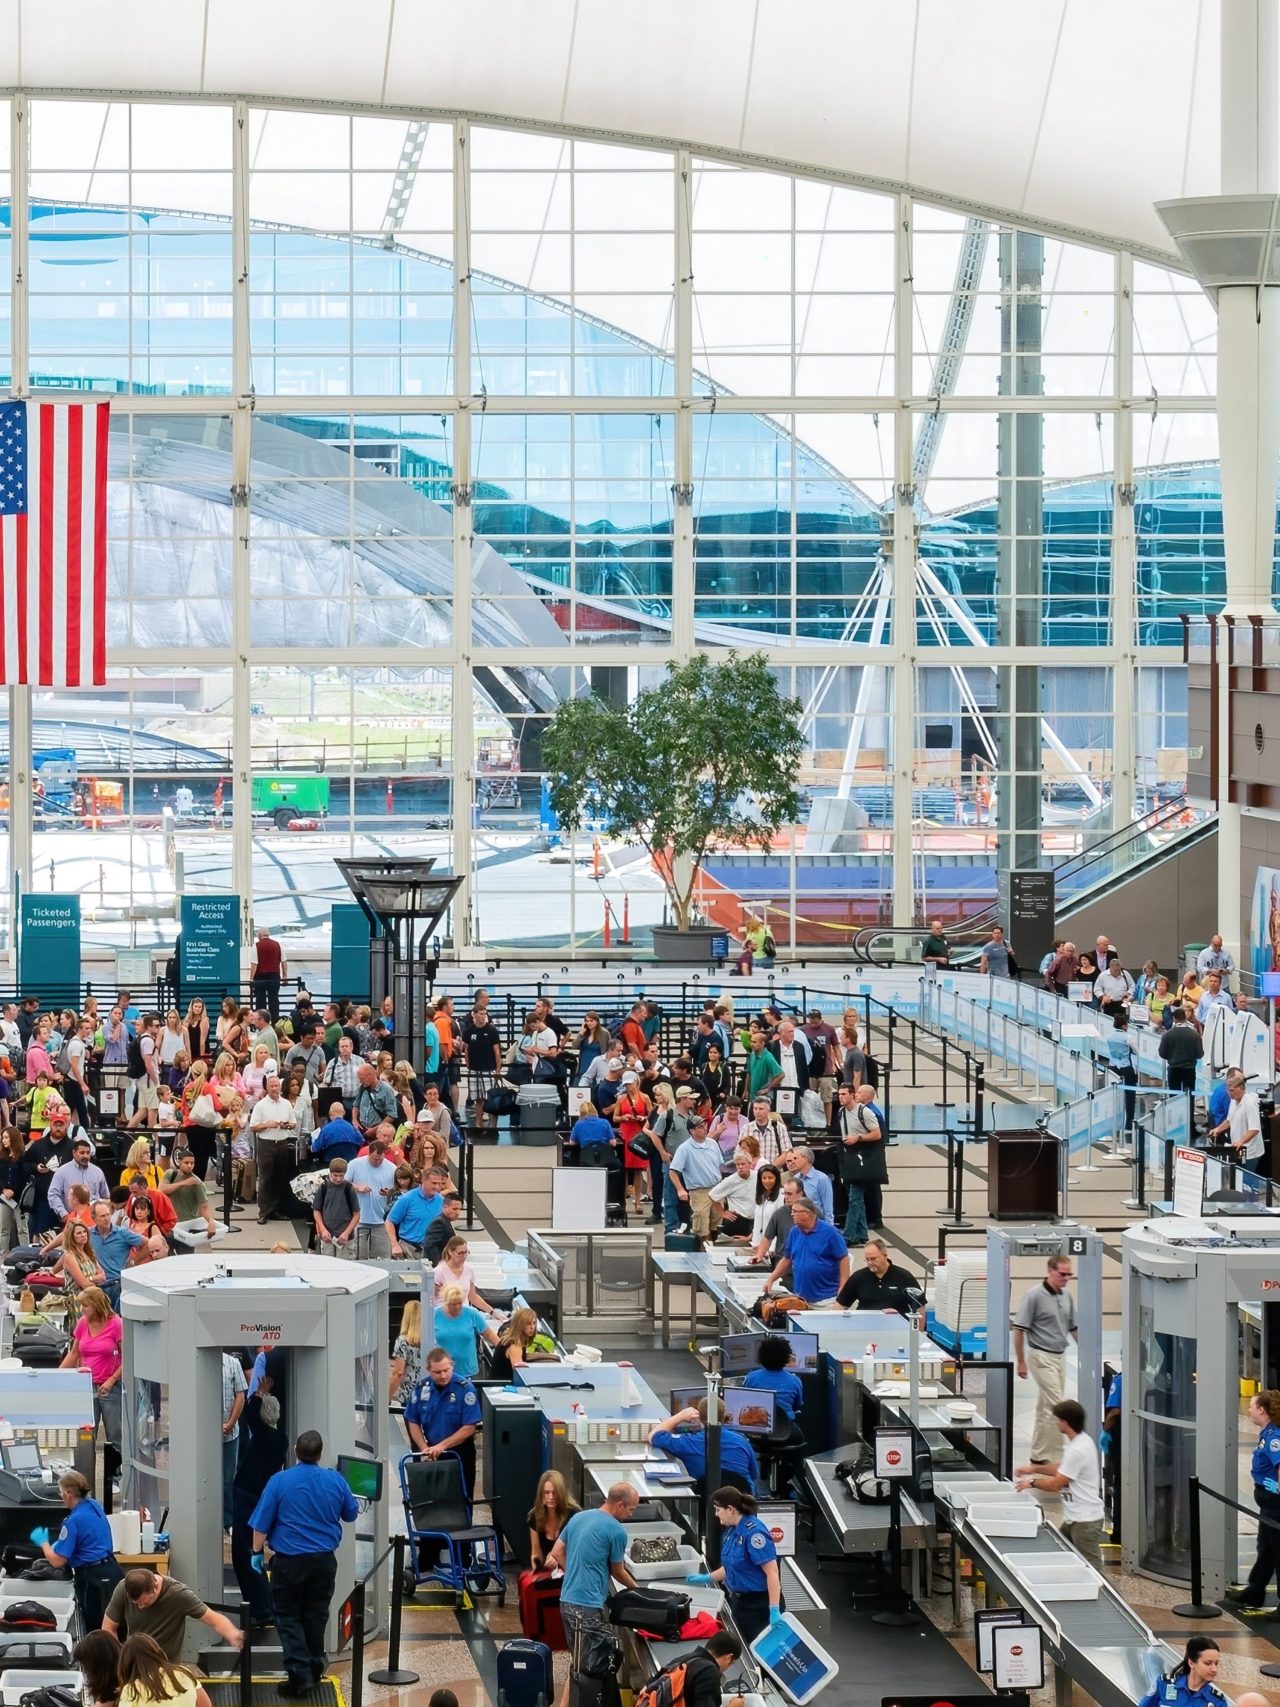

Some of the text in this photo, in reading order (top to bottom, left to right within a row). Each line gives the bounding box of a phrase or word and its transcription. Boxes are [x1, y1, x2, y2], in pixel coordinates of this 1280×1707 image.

[191, 903, 231, 911] Restricted
[32, 908, 71, 917] Ticketed
[27, 918, 76, 928] Passengers
[1073, 1240, 1083, 1252] 8
[240, 1324, 281, 1332] ProVision
[262, 1332, 281, 1340] ATD
[711, 1380, 717, 1392] 7
